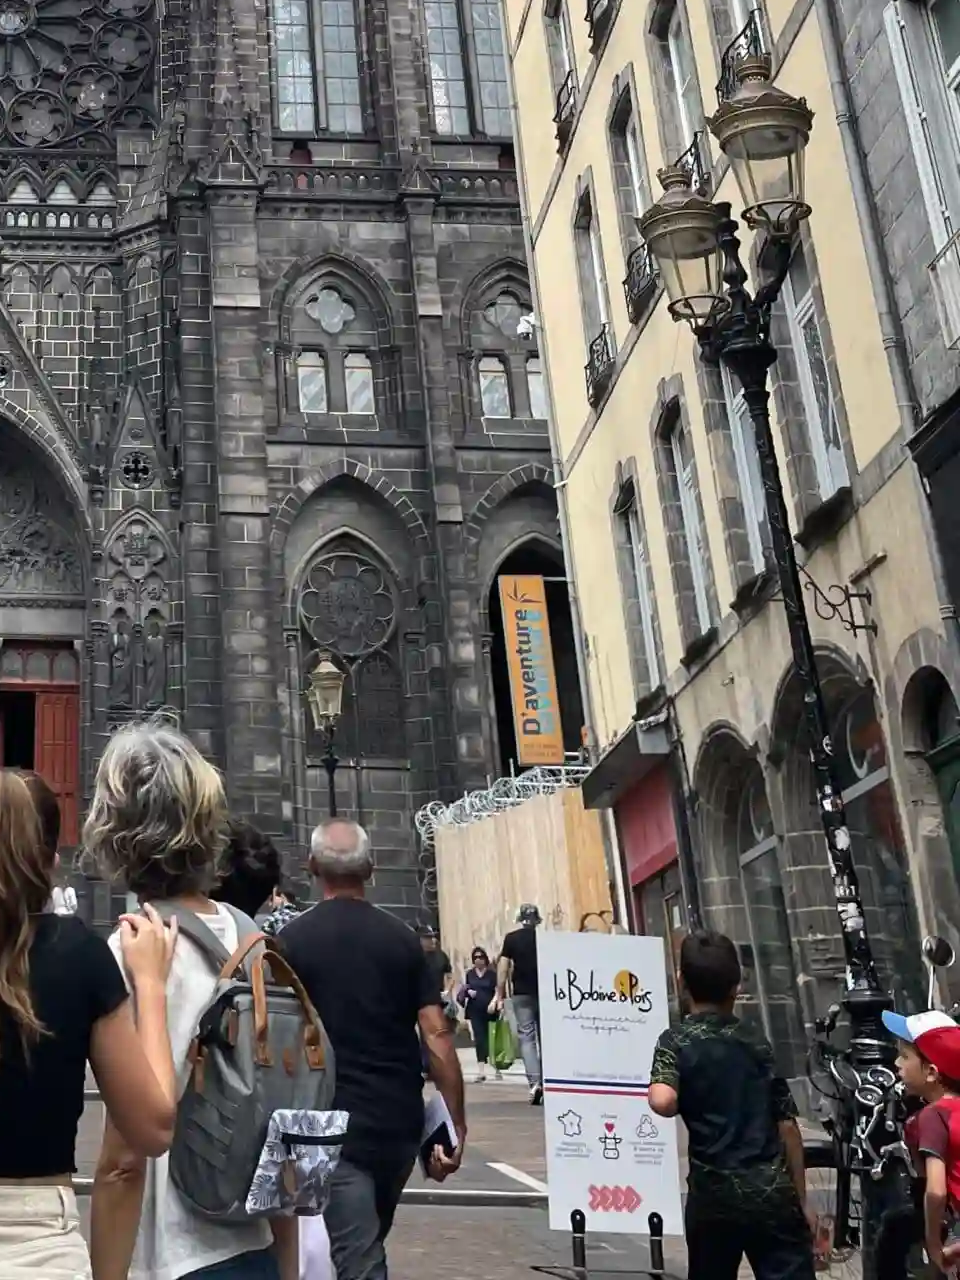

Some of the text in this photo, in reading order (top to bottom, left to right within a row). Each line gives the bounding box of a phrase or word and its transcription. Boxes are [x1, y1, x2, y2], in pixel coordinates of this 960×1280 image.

[514, 608, 543, 736] D'aventure
[567, 968, 617, 1011] Bobine
[628, 971, 653, 1013] Pois
